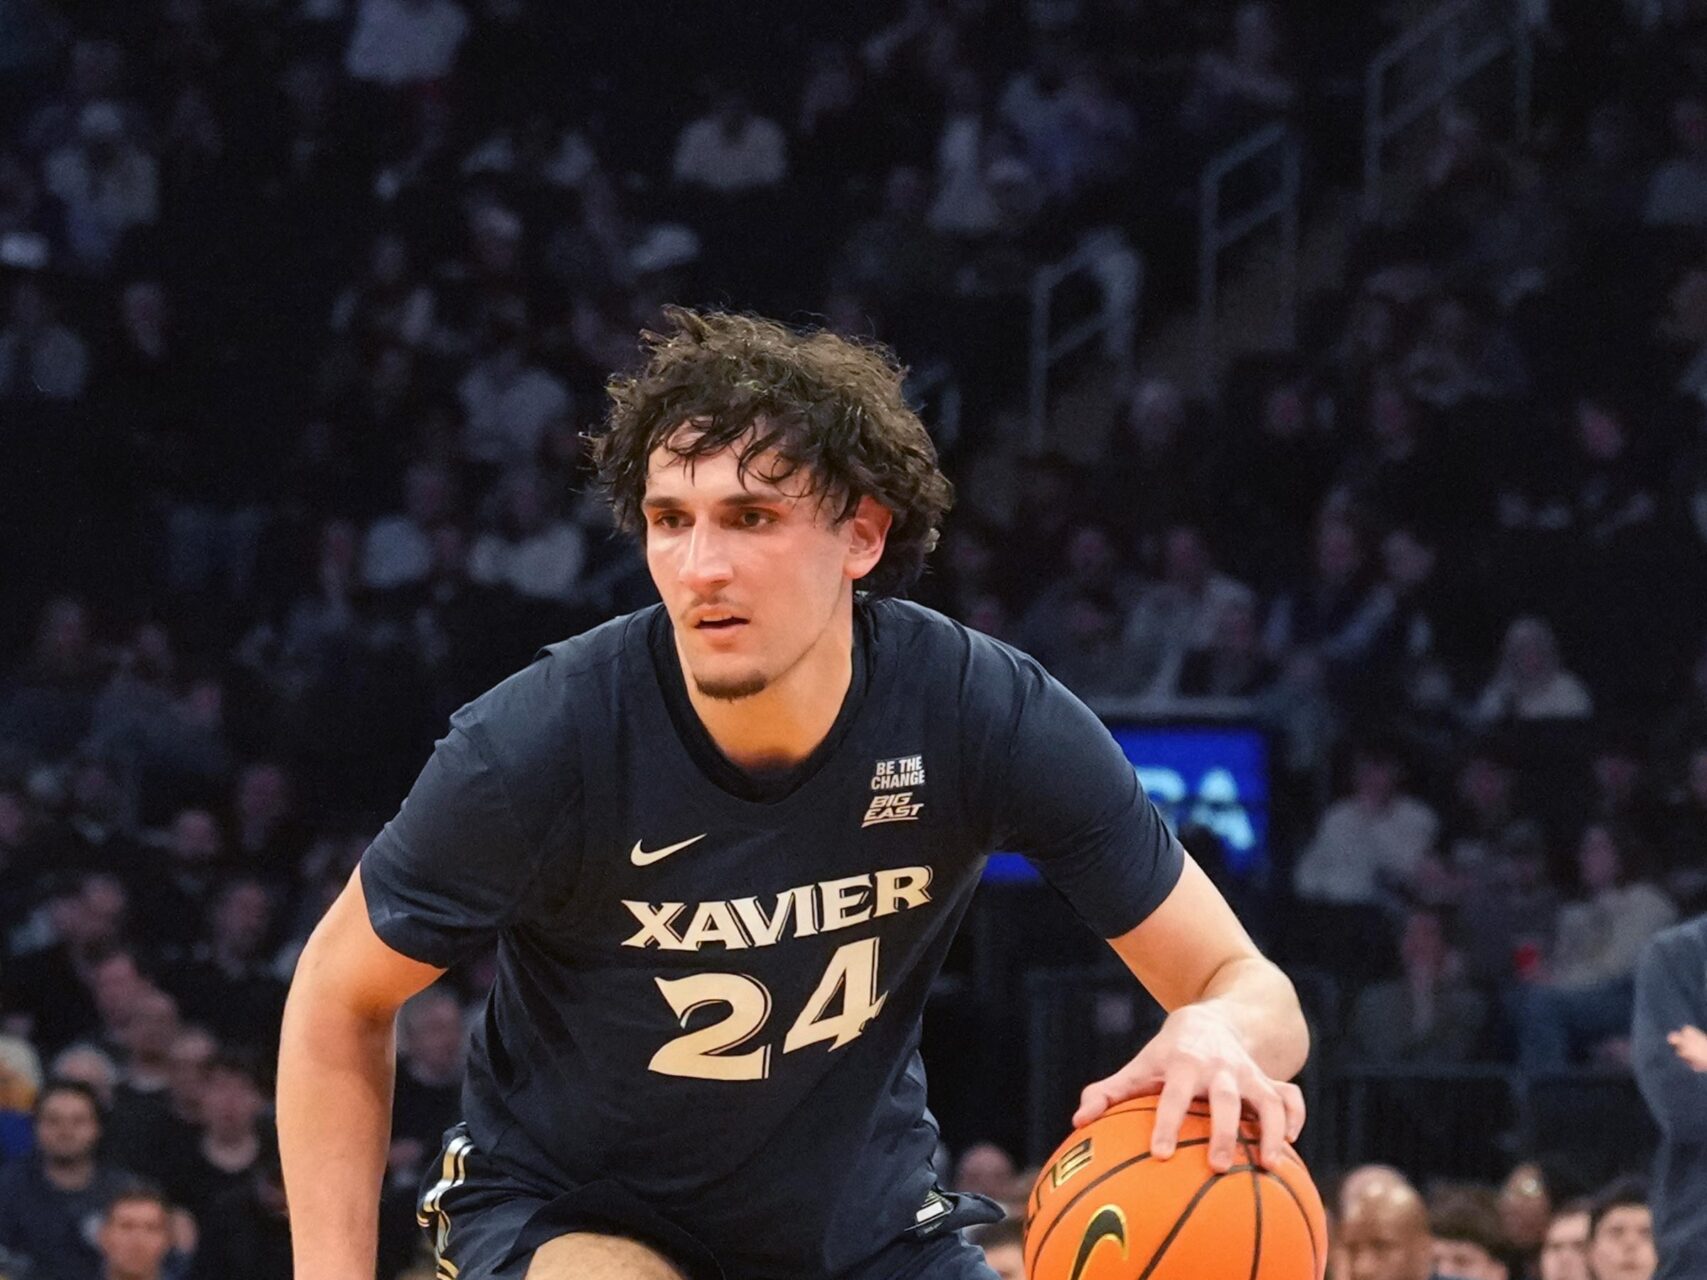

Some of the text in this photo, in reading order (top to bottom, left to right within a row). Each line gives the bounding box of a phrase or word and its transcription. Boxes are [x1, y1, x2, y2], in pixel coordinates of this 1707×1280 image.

[876, 756, 922, 776] BE THE
[871, 770, 925, 790] CHANGE
[870, 792, 913, 808] BIG
[864, 803, 924, 821] EAST
[621, 865, 933, 952] XAVIER
[647, 936, 889, 1081] 24
